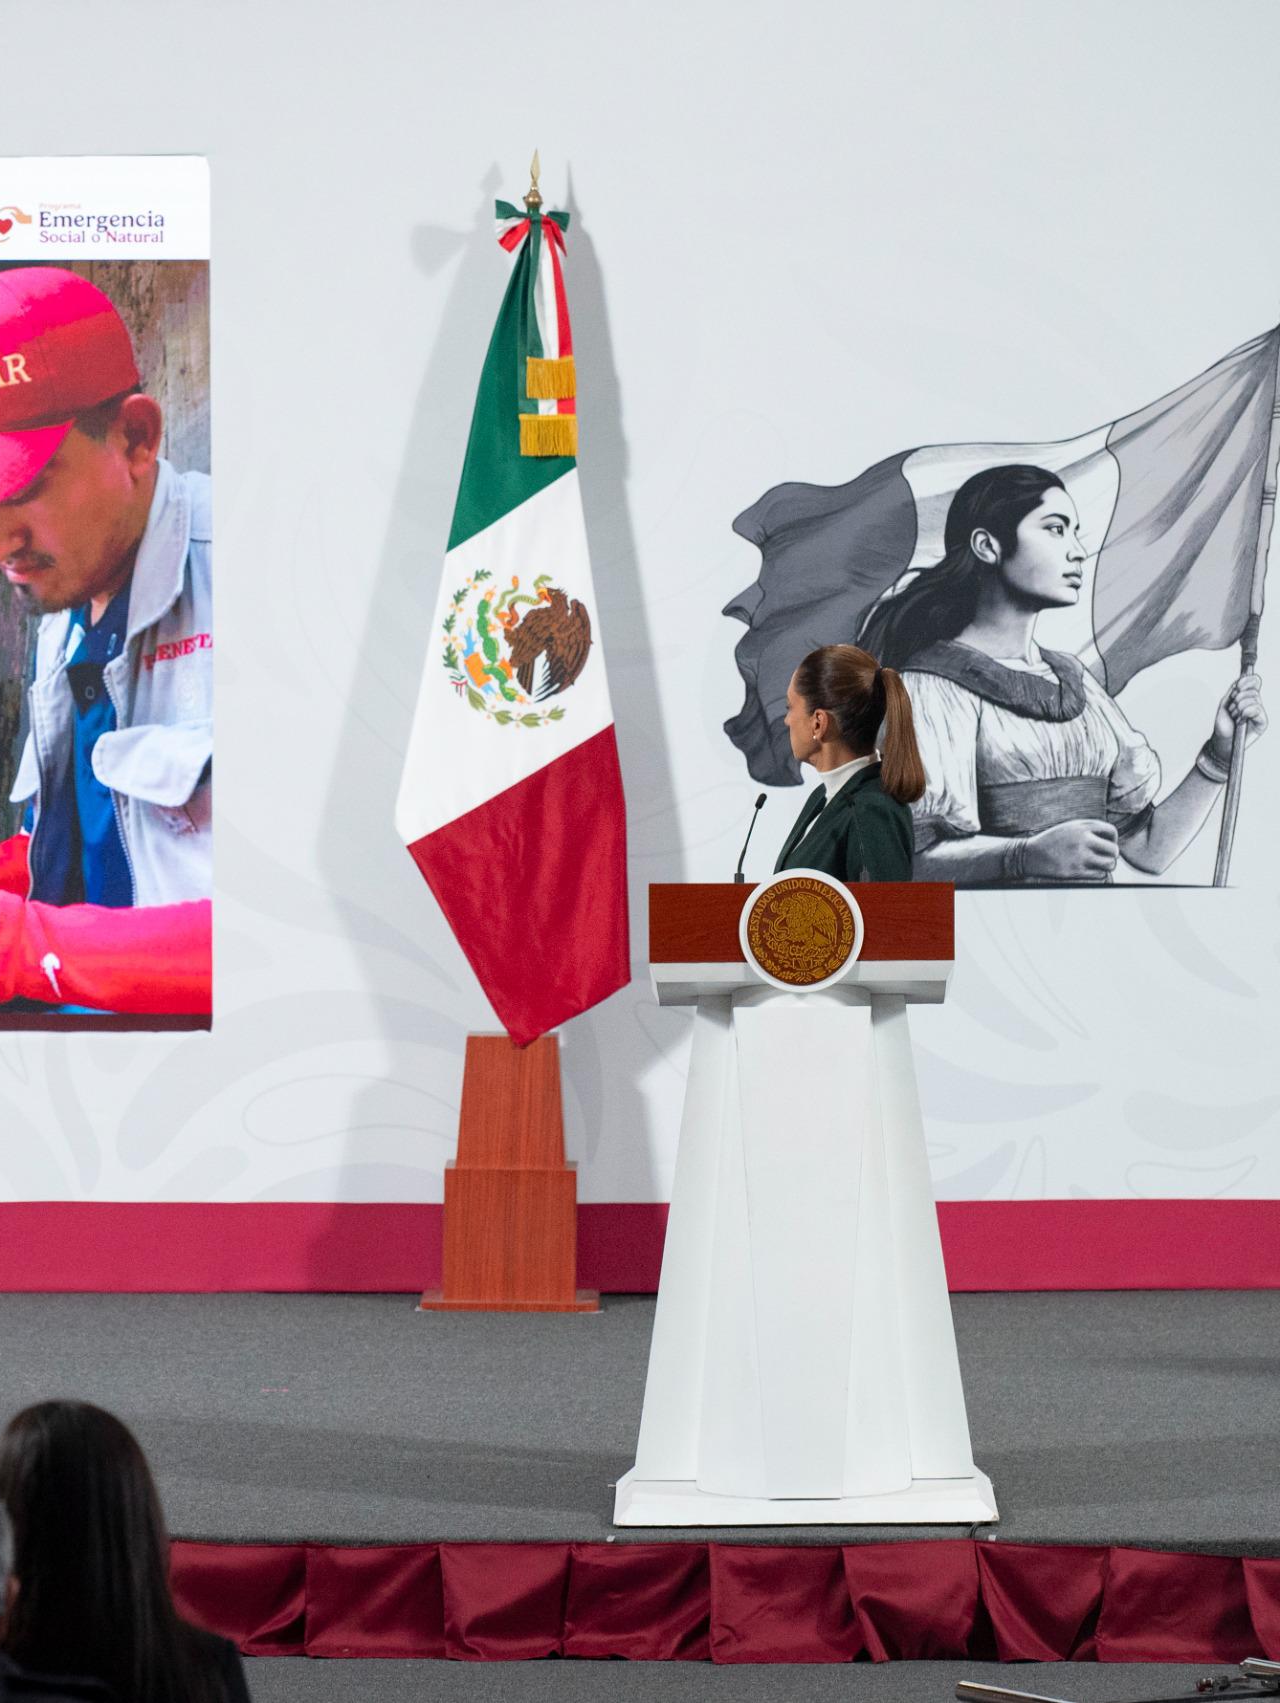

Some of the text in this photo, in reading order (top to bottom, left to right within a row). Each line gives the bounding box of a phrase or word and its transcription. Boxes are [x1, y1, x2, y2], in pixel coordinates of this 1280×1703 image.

[39, 210, 165, 233] Emergencia
[39, 229, 164, 244] Social o Natural
[750, 879, 853, 931] ESTADOS UNIDOS MEXICANOS
